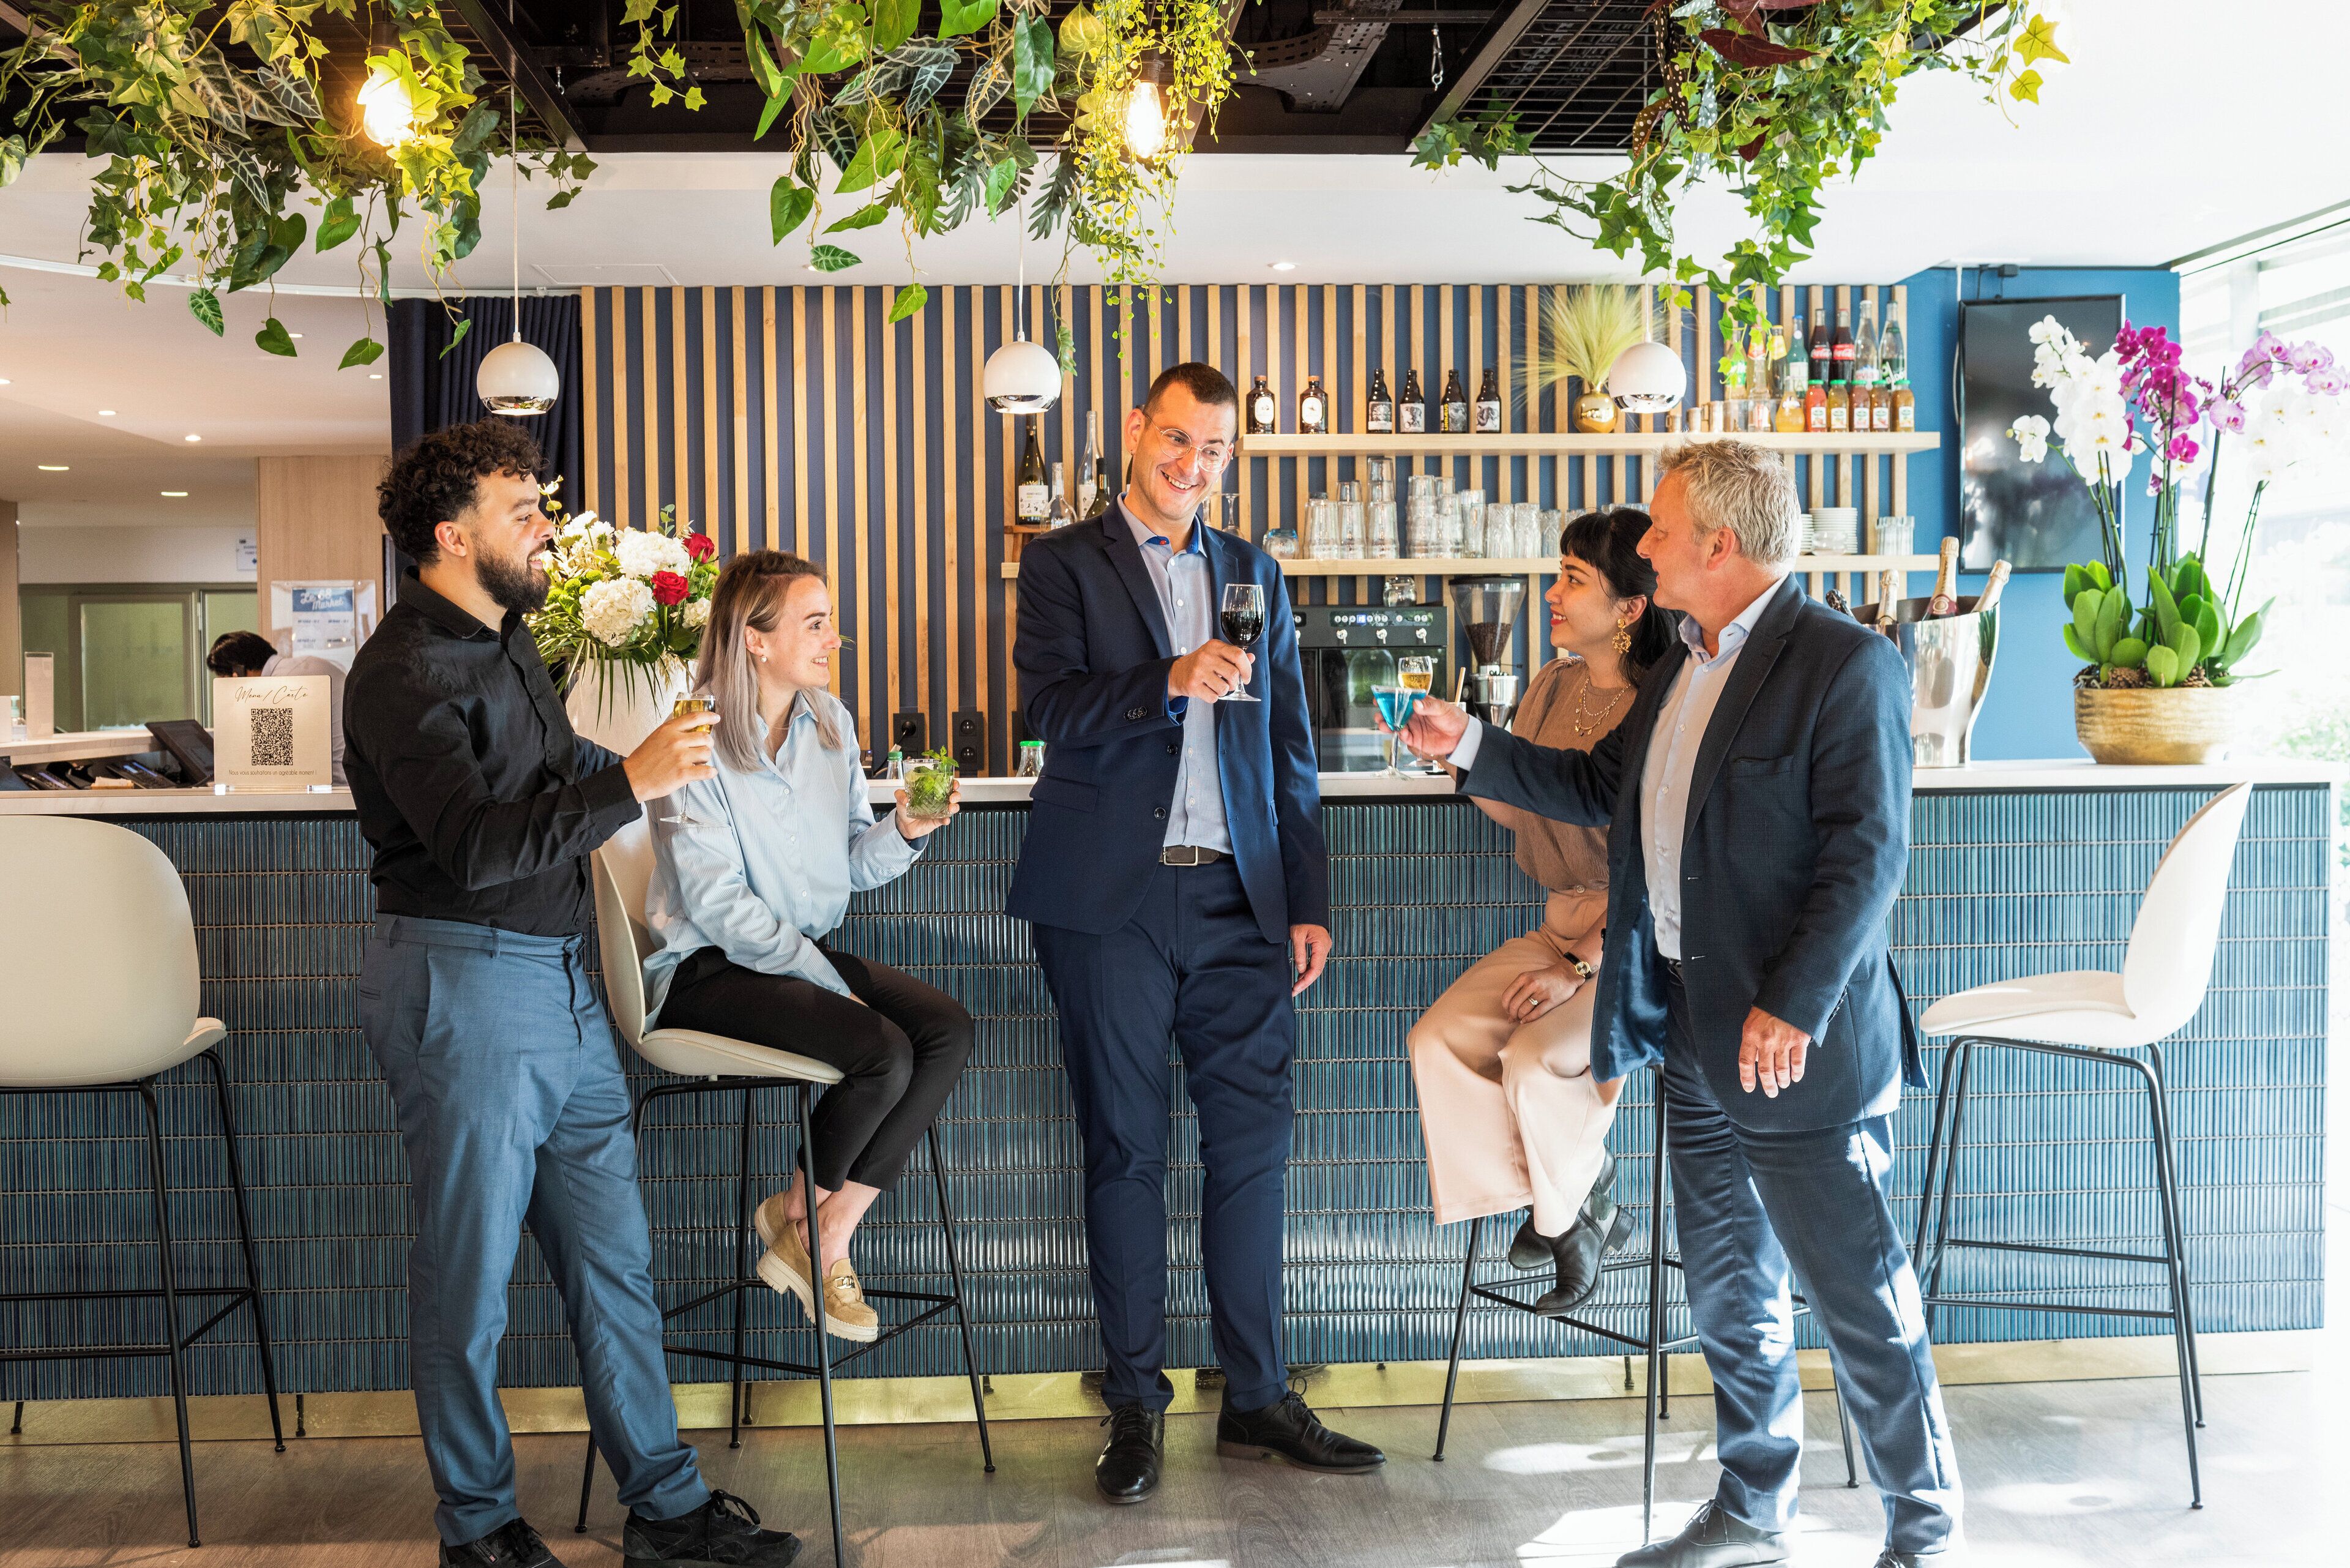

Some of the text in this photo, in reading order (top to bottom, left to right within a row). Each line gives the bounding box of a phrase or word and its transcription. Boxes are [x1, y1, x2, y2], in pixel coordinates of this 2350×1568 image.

[235, 686, 263, 703] Menu
[272, 685, 308, 704] Carte
[476, 1540, 491, 1558] Reebok
